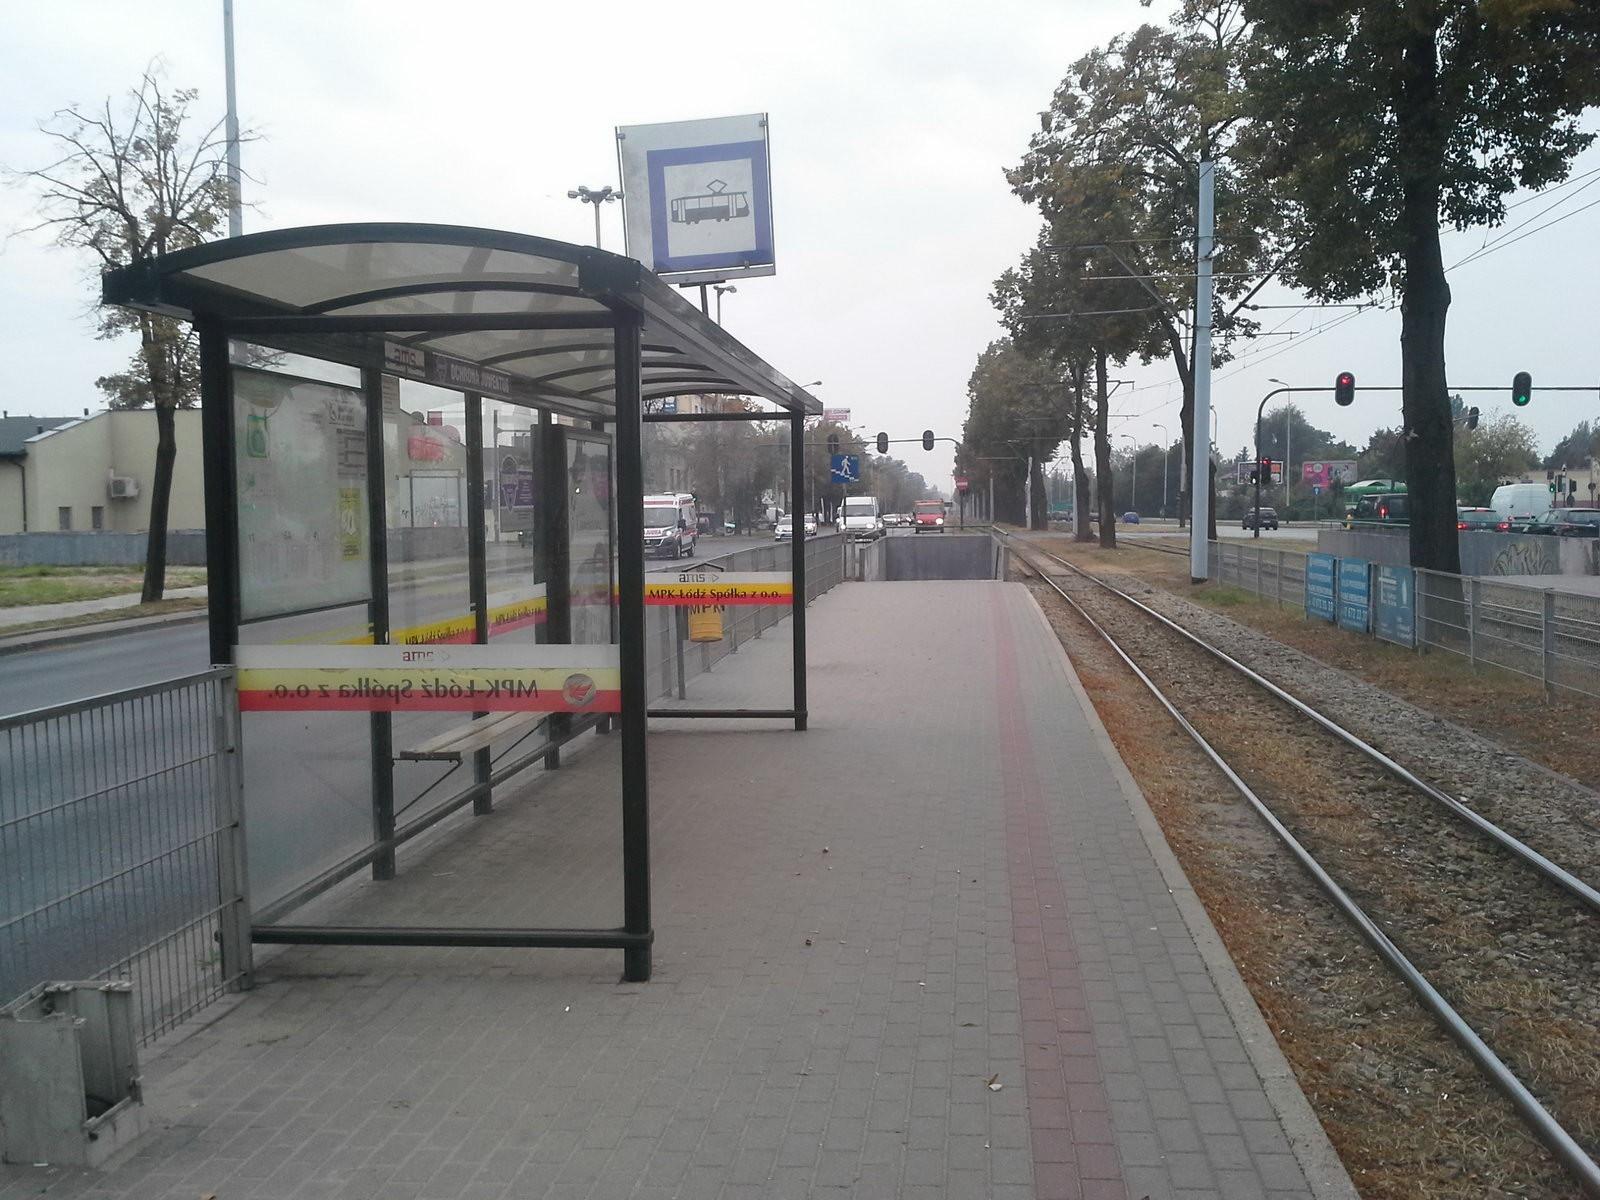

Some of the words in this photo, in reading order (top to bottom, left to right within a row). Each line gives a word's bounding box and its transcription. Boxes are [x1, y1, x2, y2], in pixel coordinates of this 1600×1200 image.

[678, 573, 706, 583] ams
[649, 588, 706, 600] MPK-Łódź
[709, 588, 747, 602] Spółka
[760, 591, 782, 599] o.o.
